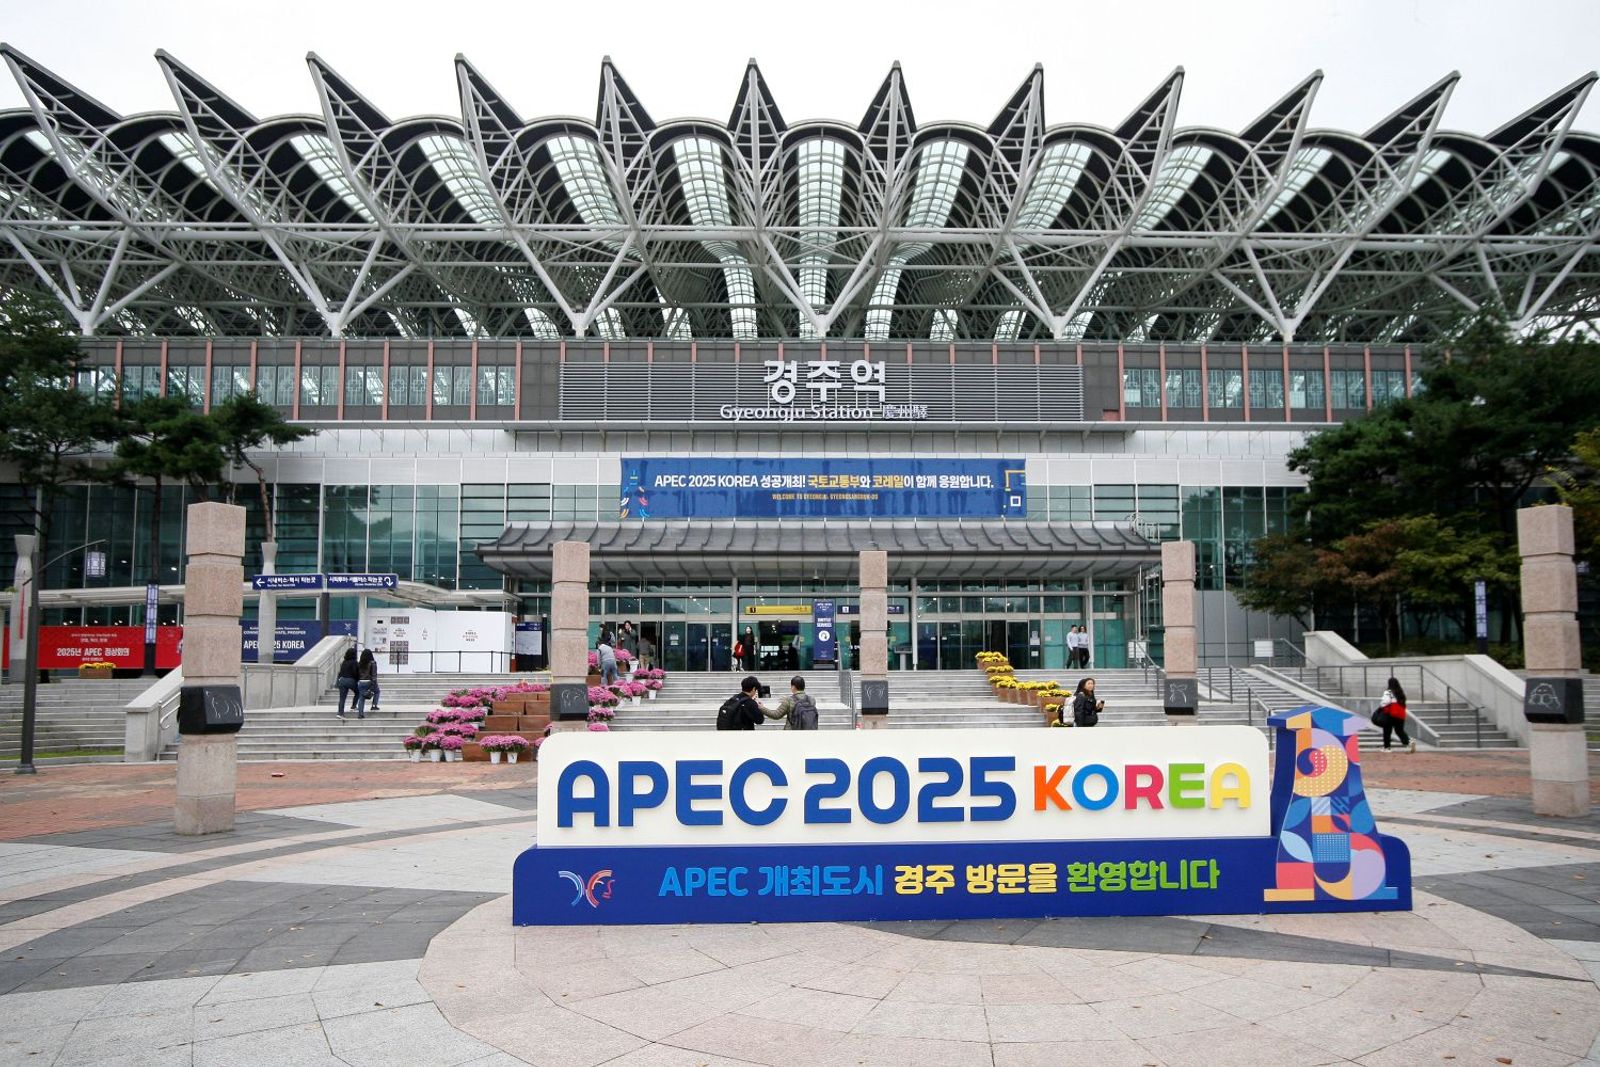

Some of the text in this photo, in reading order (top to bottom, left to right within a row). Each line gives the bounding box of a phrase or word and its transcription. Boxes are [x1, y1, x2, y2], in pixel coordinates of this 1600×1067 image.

[764, 359, 886, 404] 경주역
[720, 403, 873, 421] Gyeongju Station
[654, 474, 994, 489] APEC 2025 KOREA 성공개최! 국토교통부와 코레일이 함께 응원합니다.
[57, 647, 82, 657] 2025년
[84, 648, 102, 656] APEC
[282, 640, 305, 649] KOREA
[557, 755, 1251, 828] APEC 2025 KOREA
[658, 859, 1221, 898] APEC 개최도시 경주 방문을 환영합니다
